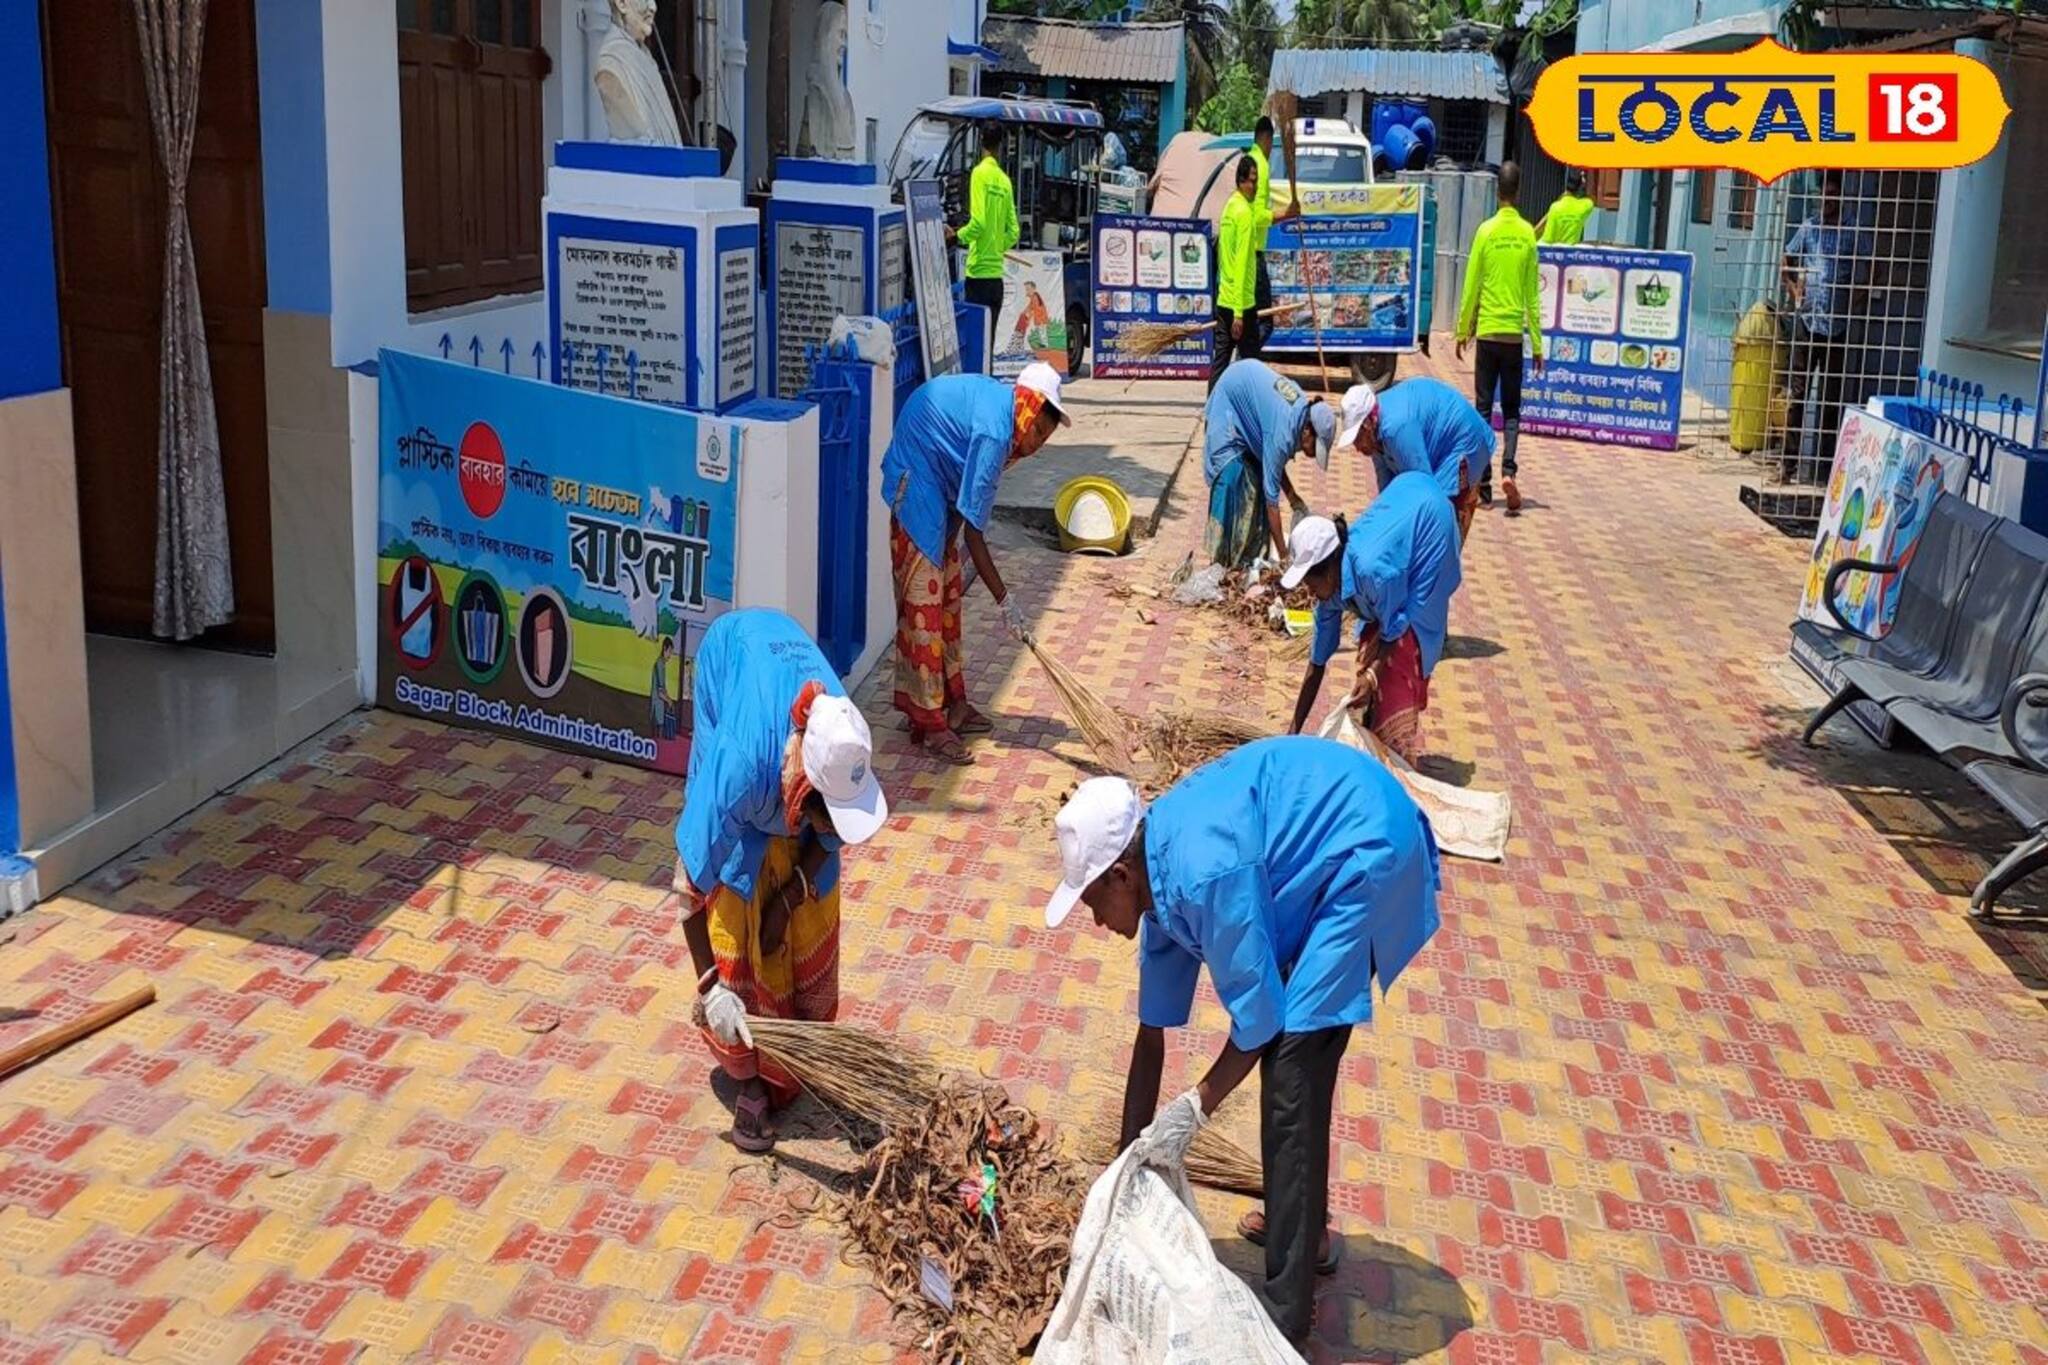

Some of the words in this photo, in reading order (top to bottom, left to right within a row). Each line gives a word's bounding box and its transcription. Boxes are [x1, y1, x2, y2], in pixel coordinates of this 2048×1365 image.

[1588, 412, 1615, 426] BANNED
[1625, 416, 1648, 431] SAGAR
[1648, 418, 1673, 433] BLOCK
[397, 427, 455, 476] প্লাস্টিক
[460, 455, 505, 485] ব্যবহার
[508, 459, 549, 496] কমিয়ে
[551, 476, 582, 507] হবে
[586, 484, 643, 518] সচেতন
[502, 539, 530, 560] ব্যবহার
[568, 513, 709, 611] বাংলা
[396, 676, 454, 713] Sagar
[455, 690, 512, 726] Block
[514, 704, 657, 760] Administration
